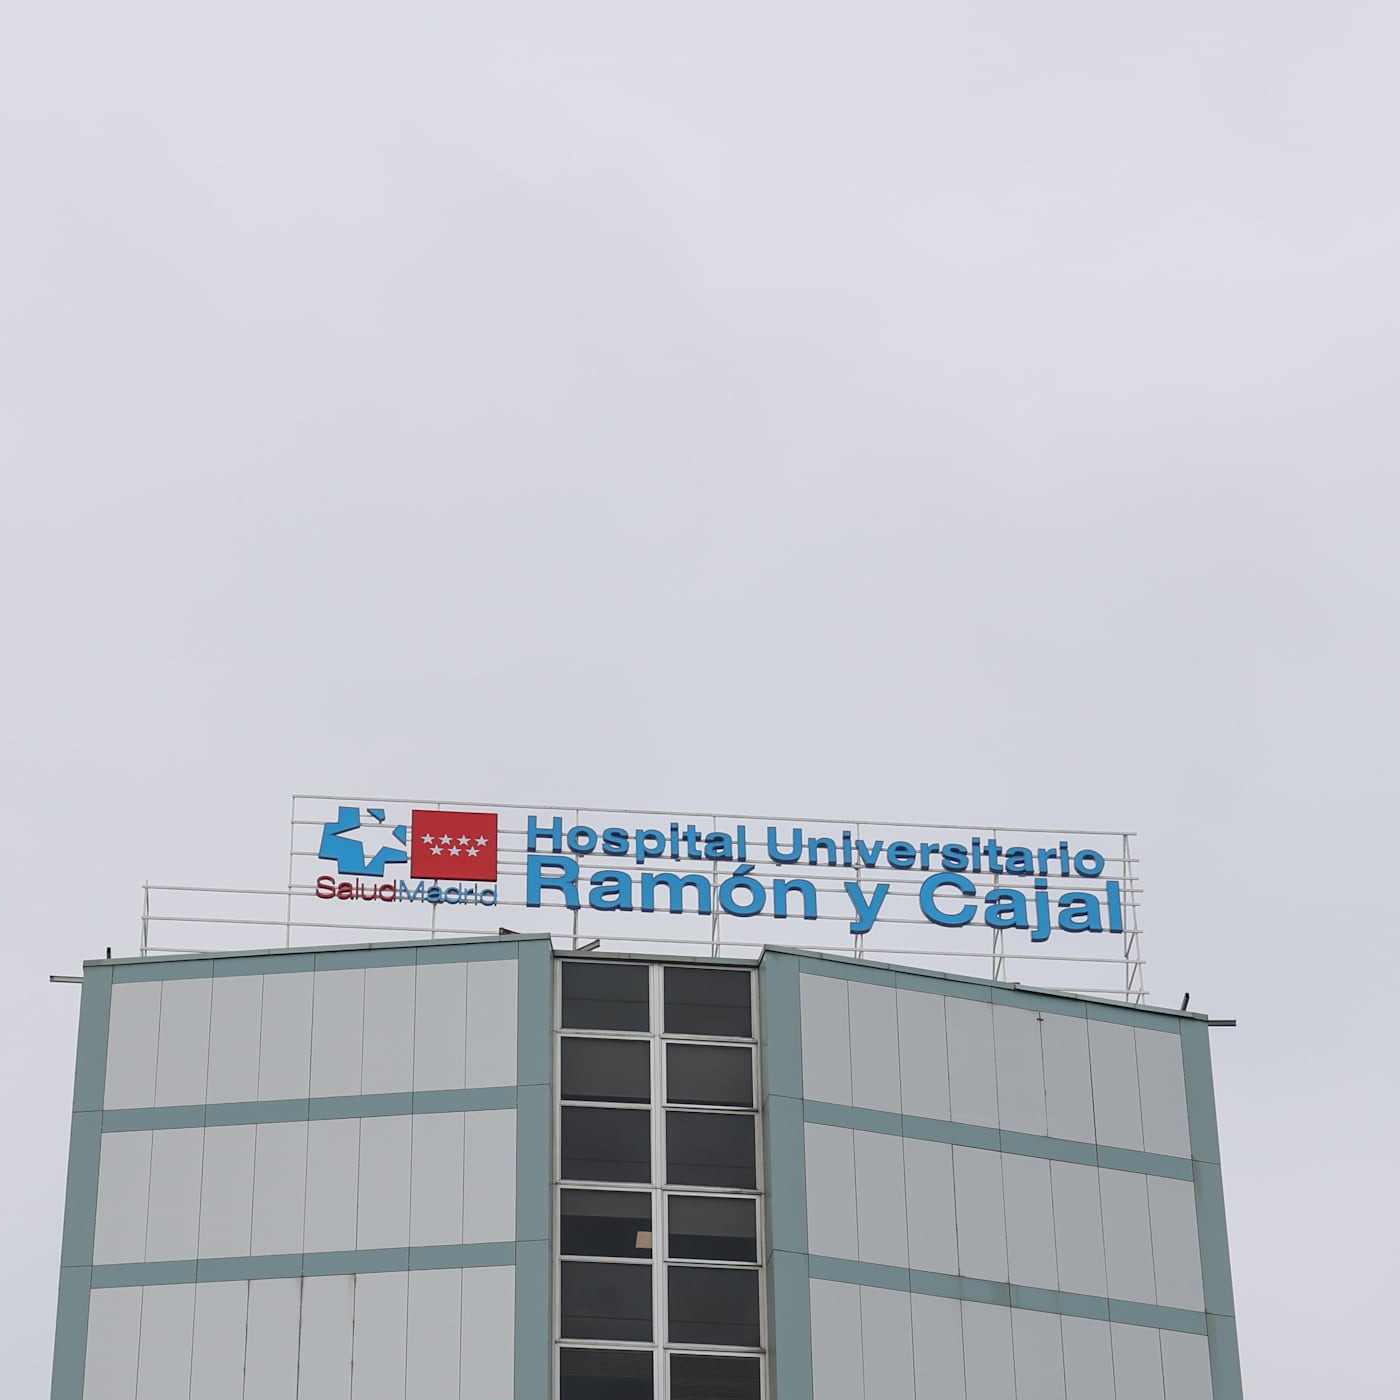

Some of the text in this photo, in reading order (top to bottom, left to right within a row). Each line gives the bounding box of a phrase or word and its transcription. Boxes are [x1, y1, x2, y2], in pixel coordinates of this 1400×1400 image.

[527, 815, 1105, 878] Hospital Universitario
[316, 875, 498, 906] SaludMadrid
[526, 854, 1124, 942] Ramón y Cajal
